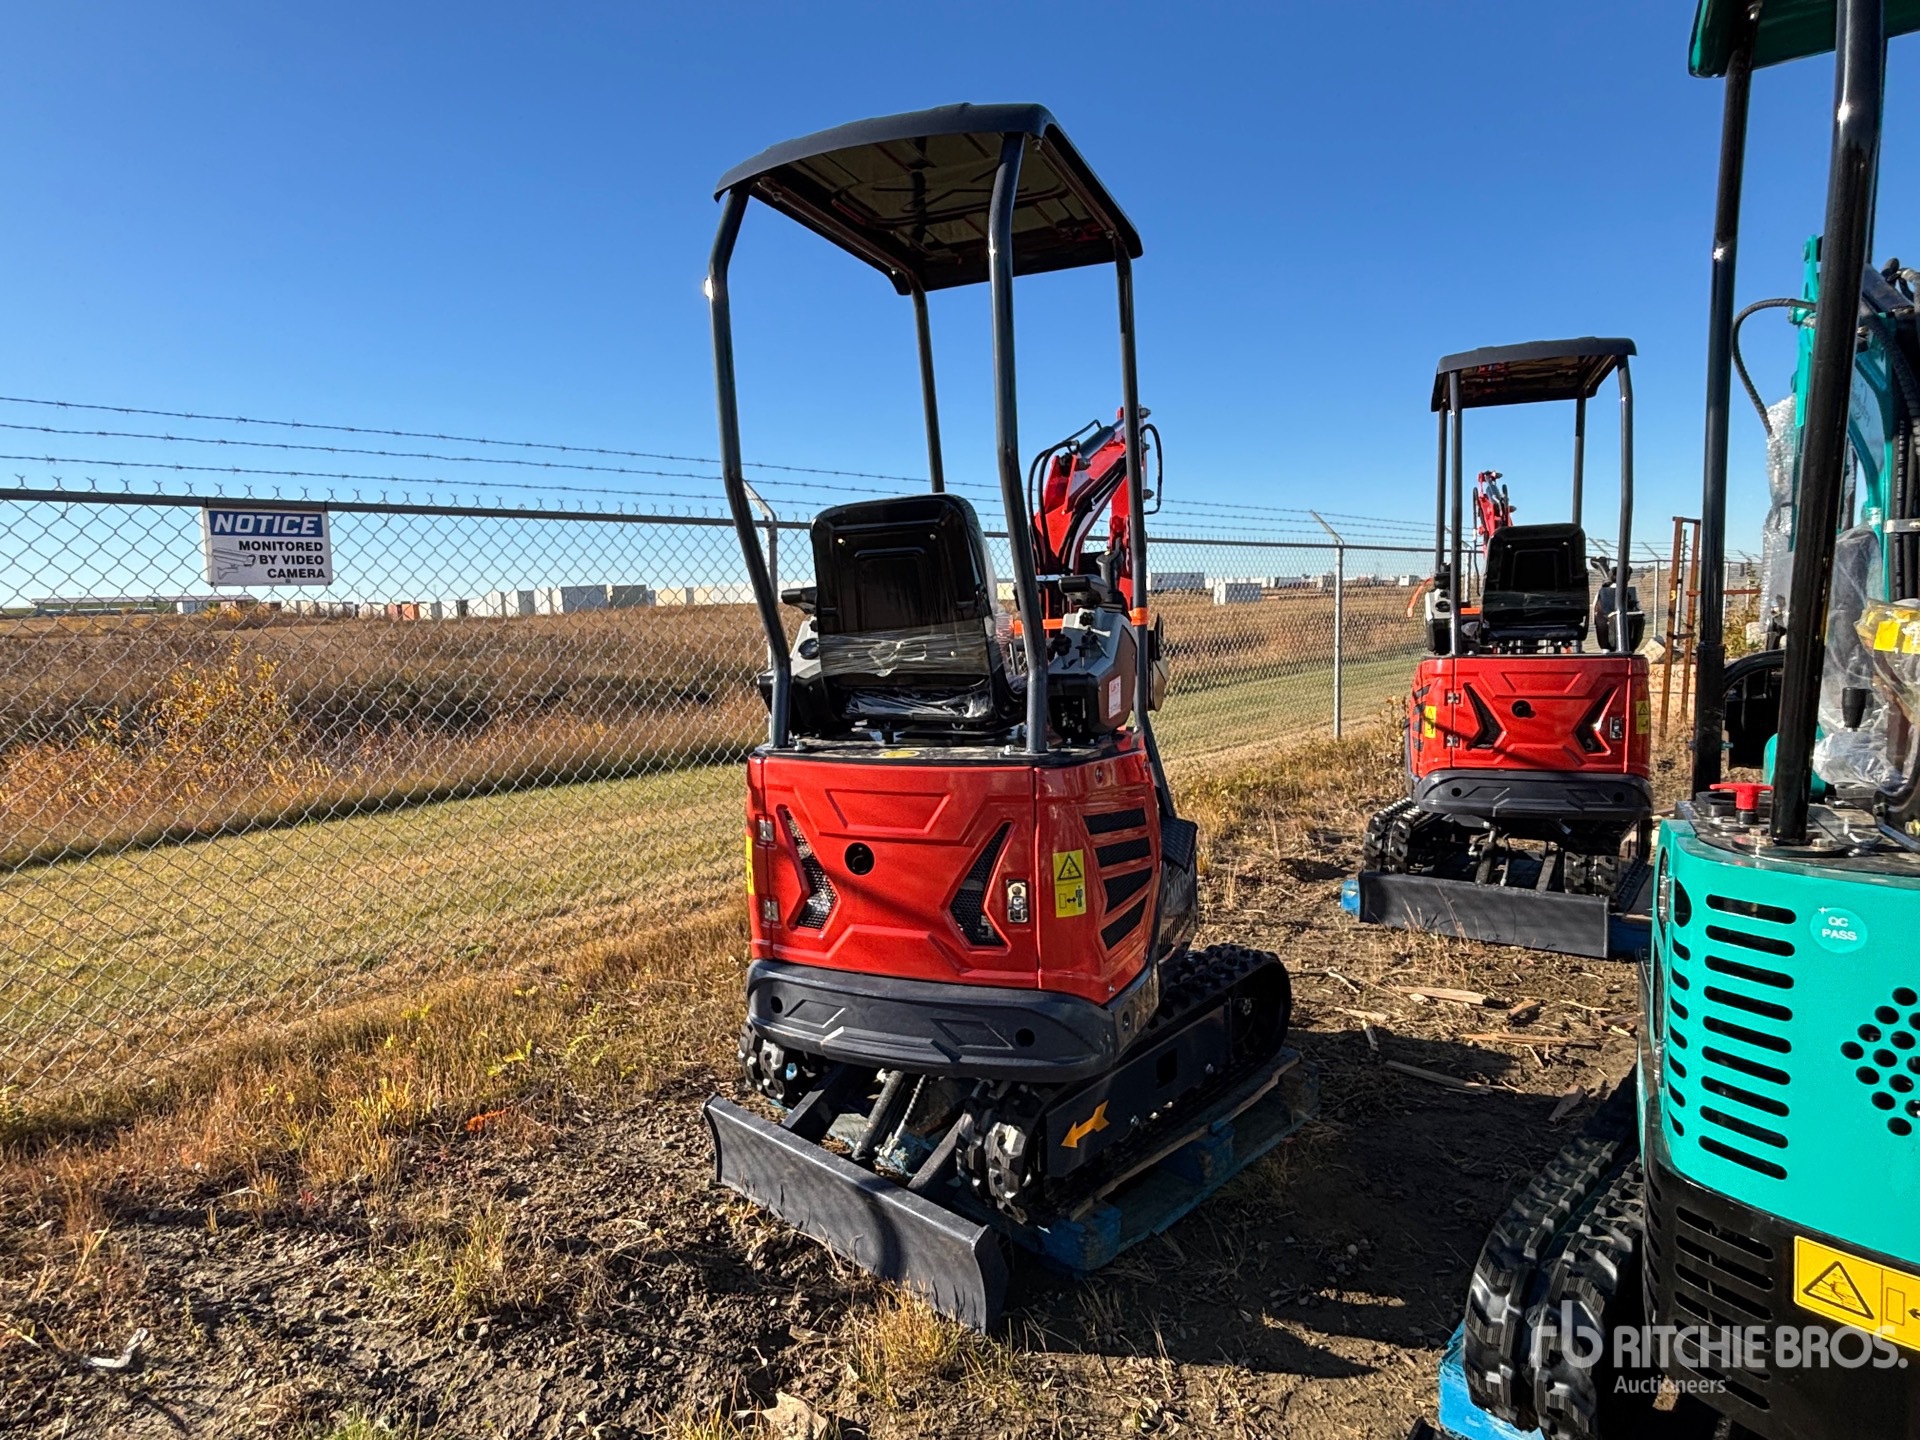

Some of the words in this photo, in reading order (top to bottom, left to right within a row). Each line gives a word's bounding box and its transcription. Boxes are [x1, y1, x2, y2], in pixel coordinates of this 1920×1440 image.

[214, 513, 318, 535] NOTICE
[238, 540, 323, 552] MONITORED
[259, 555, 277, 565] BY
[282, 555, 324, 566] VIDEO
[267, 568, 325, 579] CAMERA
[1828, 916, 1849, 928] QC
[1821, 928, 1858, 941] PASS
